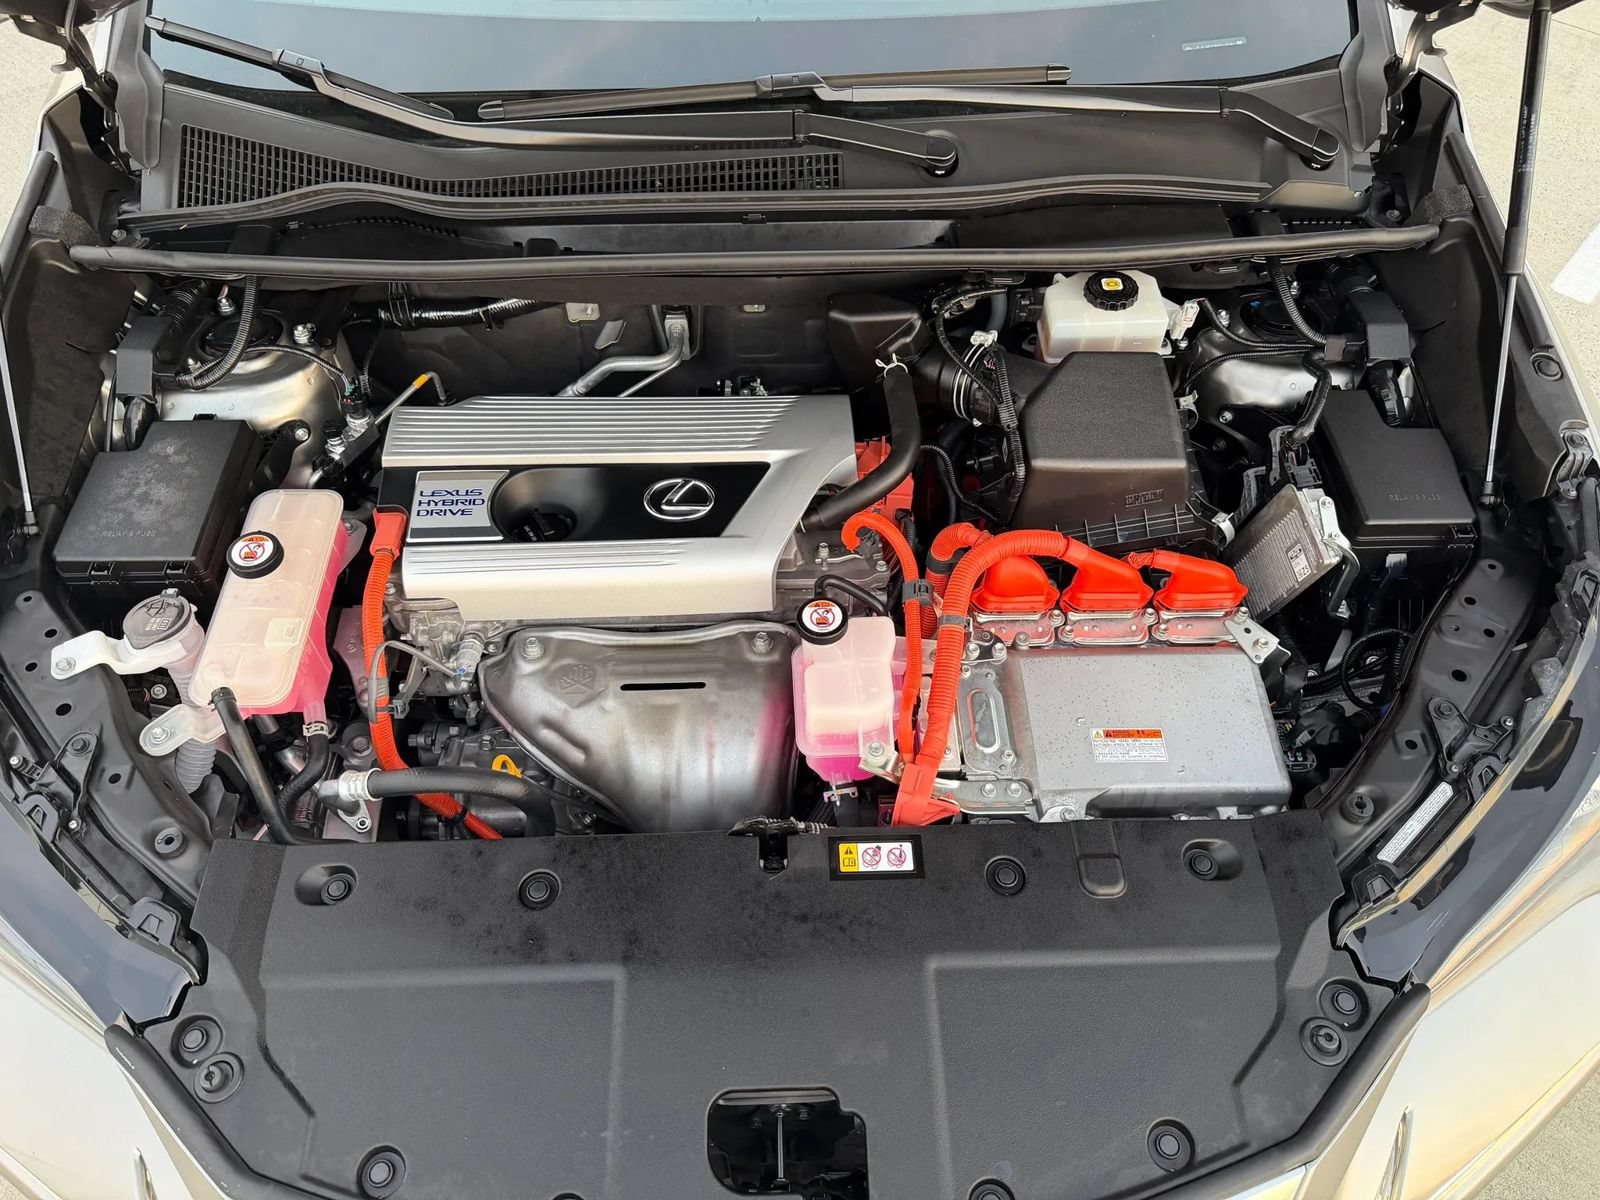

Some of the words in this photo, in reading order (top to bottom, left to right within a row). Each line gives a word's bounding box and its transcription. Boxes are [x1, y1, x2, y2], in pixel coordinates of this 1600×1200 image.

[420, 489, 483, 497] LEXUS
[418, 499, 486, 507] HYBRID
[417, 509, 473, 517] DRIVE
